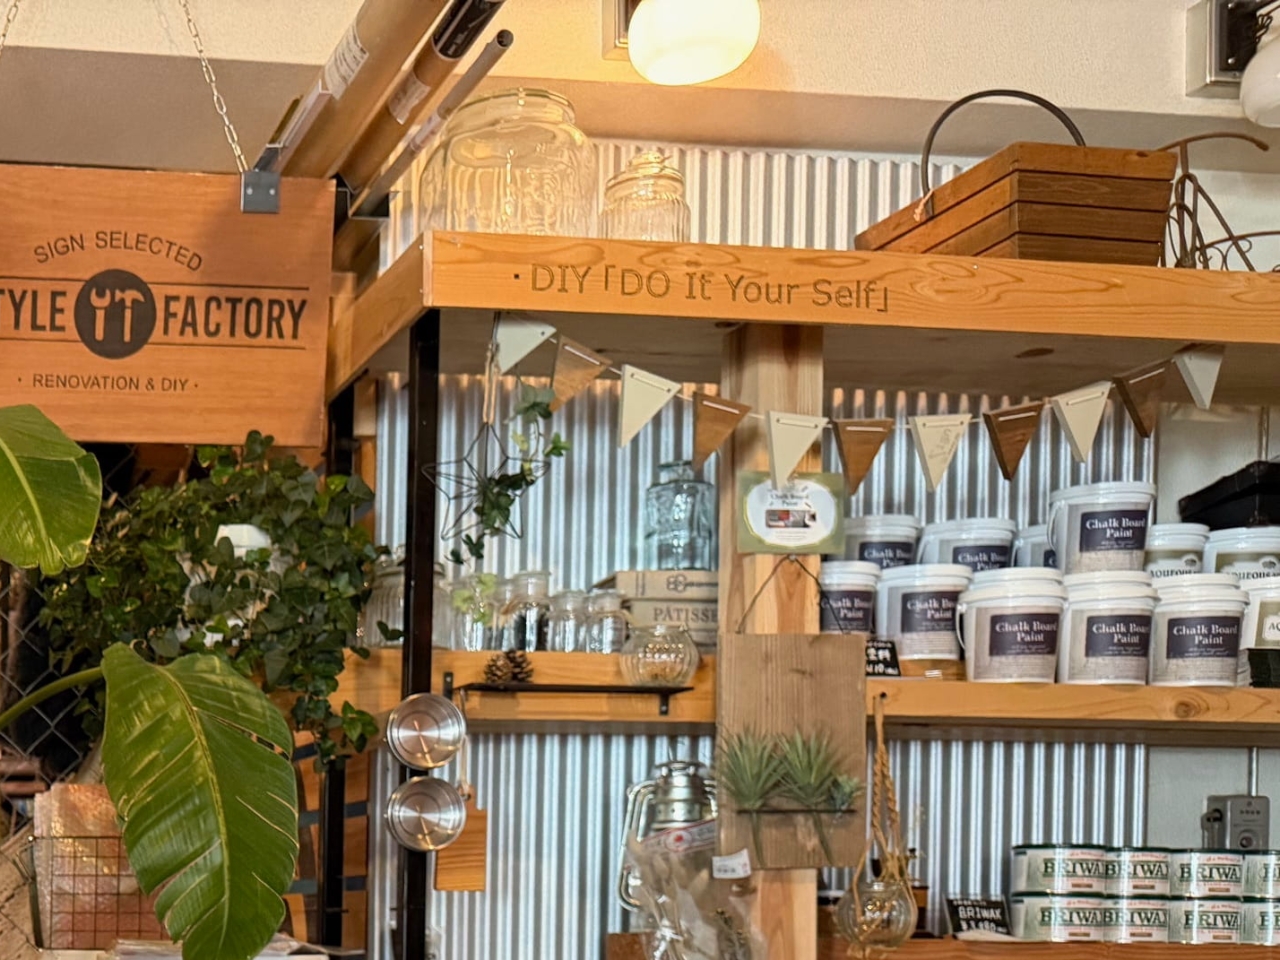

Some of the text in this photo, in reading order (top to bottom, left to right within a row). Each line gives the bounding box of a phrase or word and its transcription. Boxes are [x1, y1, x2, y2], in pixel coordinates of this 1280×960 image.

[34, 231, 203, 272] SIGN SELECTED
[531, 263, 592, 294] DIY
[685, 272, 712, 300] It
[724, 274, 800, 305] Your
[162, 294, 308, 341] FACTORY
[32, 373, 189, 391] RENOVATION & DIY
[1086, 518, 1120, 530] Chalk
[1106, 529, 1133, 539] Paint
[864, 549, 894, 560] Chalk
[958, 552, 988, 563] Chalk
[907, 598, 939, 611] Chalk
[839, 609, 864, 619] Paint
[926, 609, 953, 620] Paint
[995, 621, 1030, 633] Chalk
[1092, 622, 1127, 634] Chalk
[1173, 625, 1208, 636] Chalk
[1017, 632, 1044, 643] Paint
[1113, 633, 1140, 644] Paint
[1194, 634, 1223, 645] Paint
[959, 906, 1002, 920] BRIWAX
